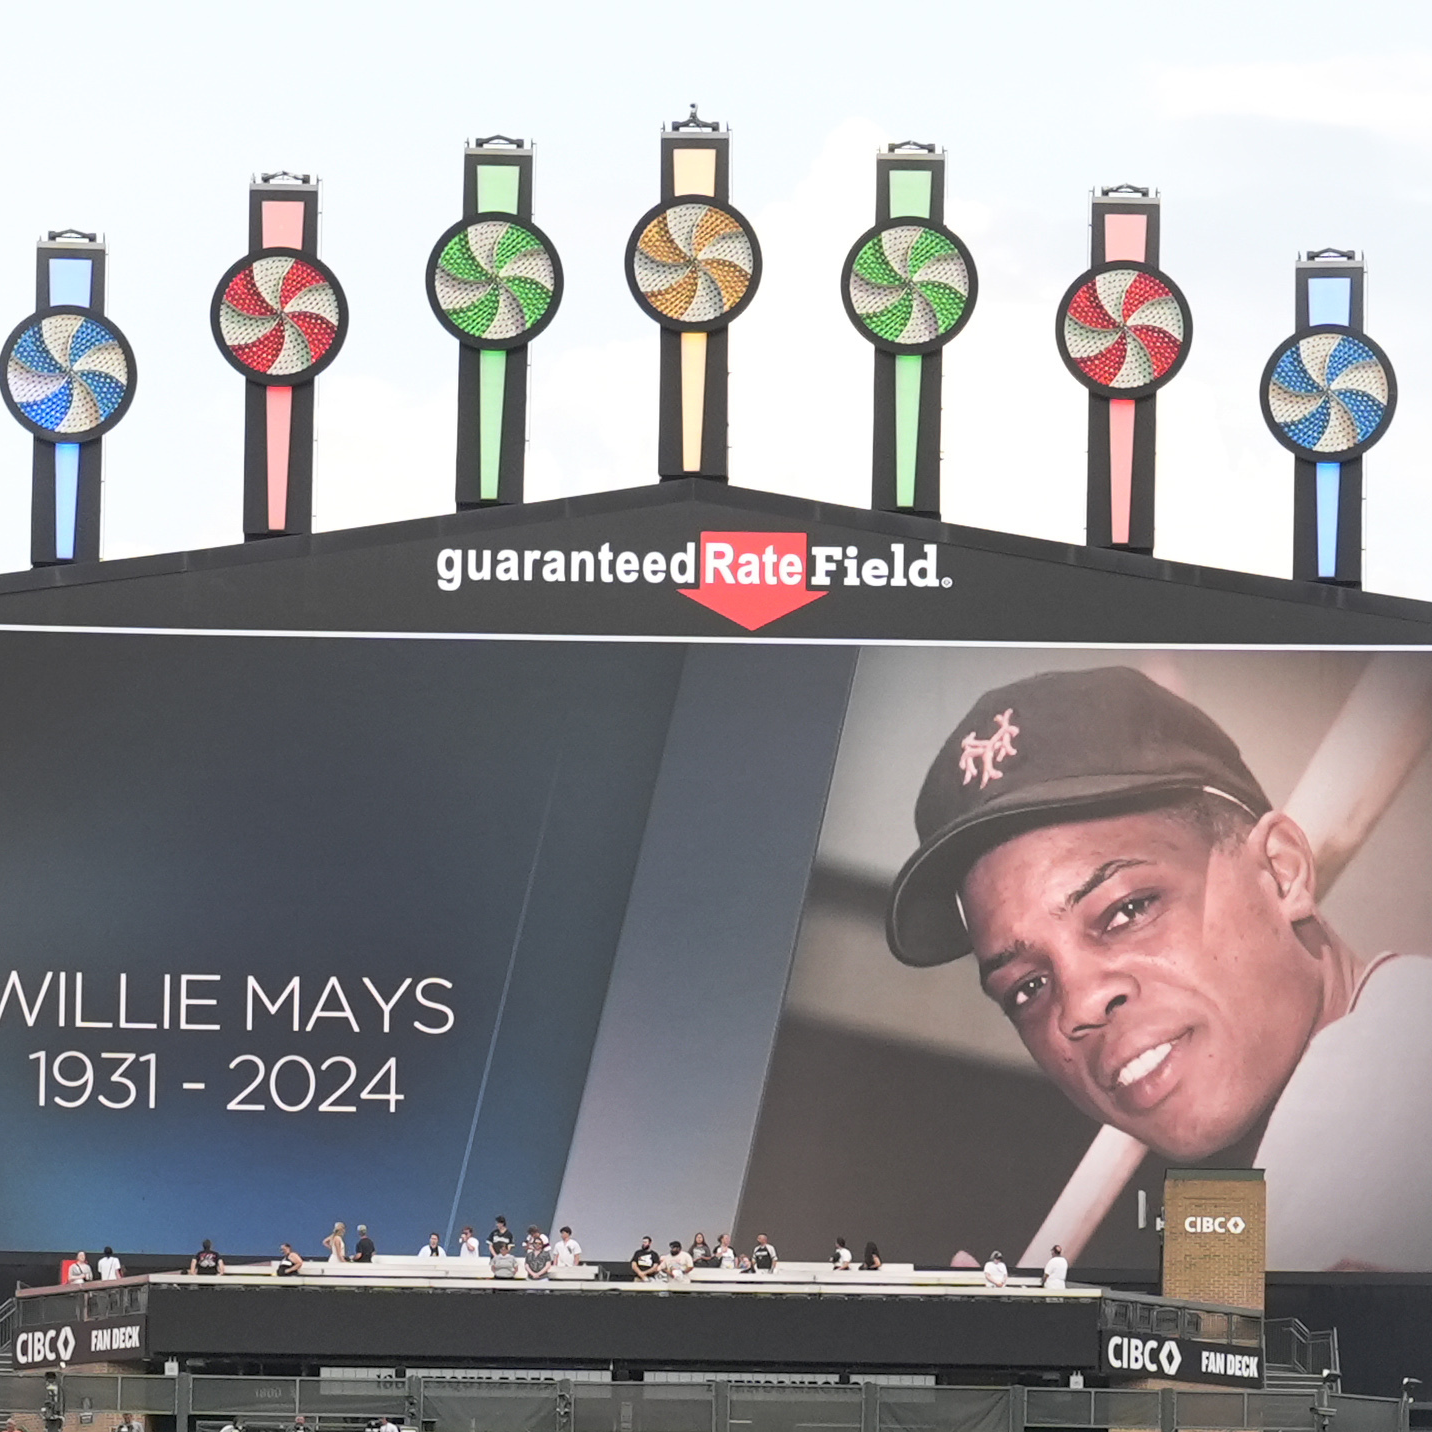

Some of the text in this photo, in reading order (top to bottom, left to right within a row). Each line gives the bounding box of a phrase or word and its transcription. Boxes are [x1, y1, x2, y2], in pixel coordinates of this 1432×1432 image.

[436, 542, 696, 591] guaranteed
[703, 542, 803, 585] Rate
[247, 975, 455, 1034] MAYS
[29, 1051, 156, 1109] 1931
[226, 1054, 405, 1113] 2024
[1184, 1216, 1226, 1233] CIBC
[16, 1325, 140, 1364] CIBC FAN DECK
[1108, 1336, 1258, 1378] CIBC FAN DECK
